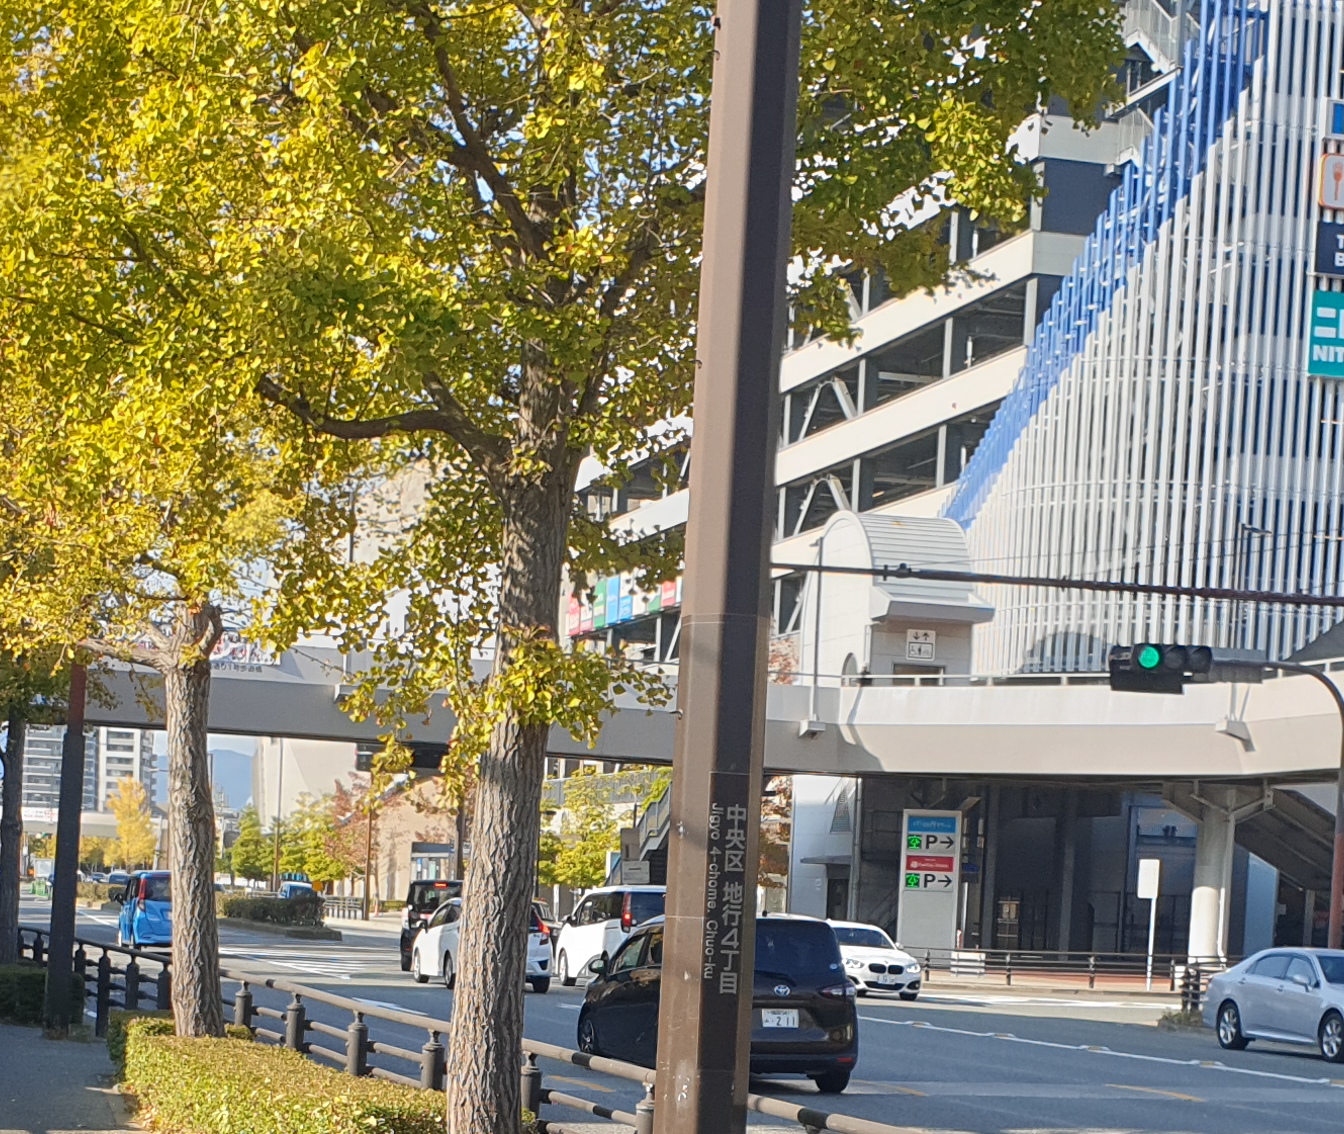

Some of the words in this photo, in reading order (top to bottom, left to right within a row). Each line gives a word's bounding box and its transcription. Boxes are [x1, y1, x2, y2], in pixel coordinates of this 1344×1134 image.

[709, 802, 725, 840] Jigyo
[724, 803, 747, 872] 中央区
[925, 834, 939, 850] P
[923, 873, 937, 889] P
[703, 920, 719, 979] Chuo-ku
[719, 881, 744, 995] 地行4丁目
